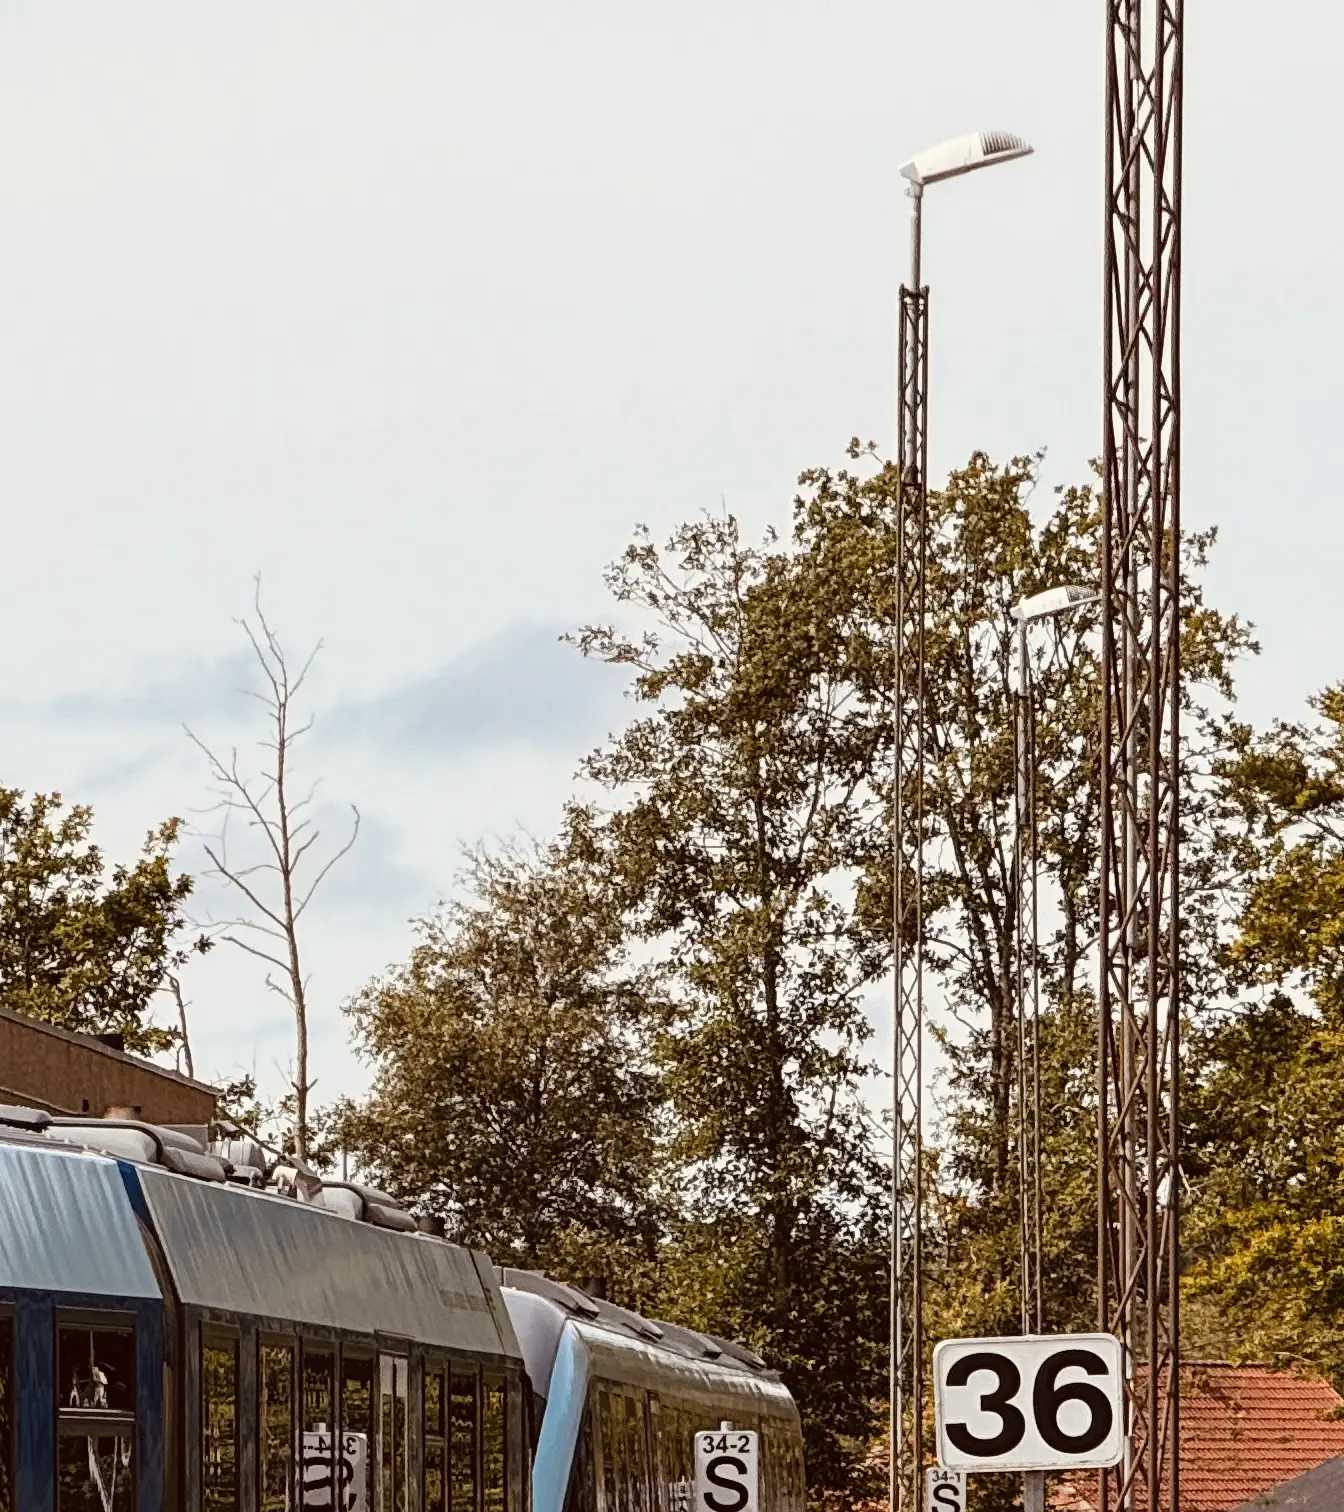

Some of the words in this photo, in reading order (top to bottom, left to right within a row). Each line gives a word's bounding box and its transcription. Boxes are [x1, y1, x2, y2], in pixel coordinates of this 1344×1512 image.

[944, 1348, 1114, 1458] 36
[702, 1434, 751, 1454] 34-2
[931, 1469, 962, 1483] 34-1
